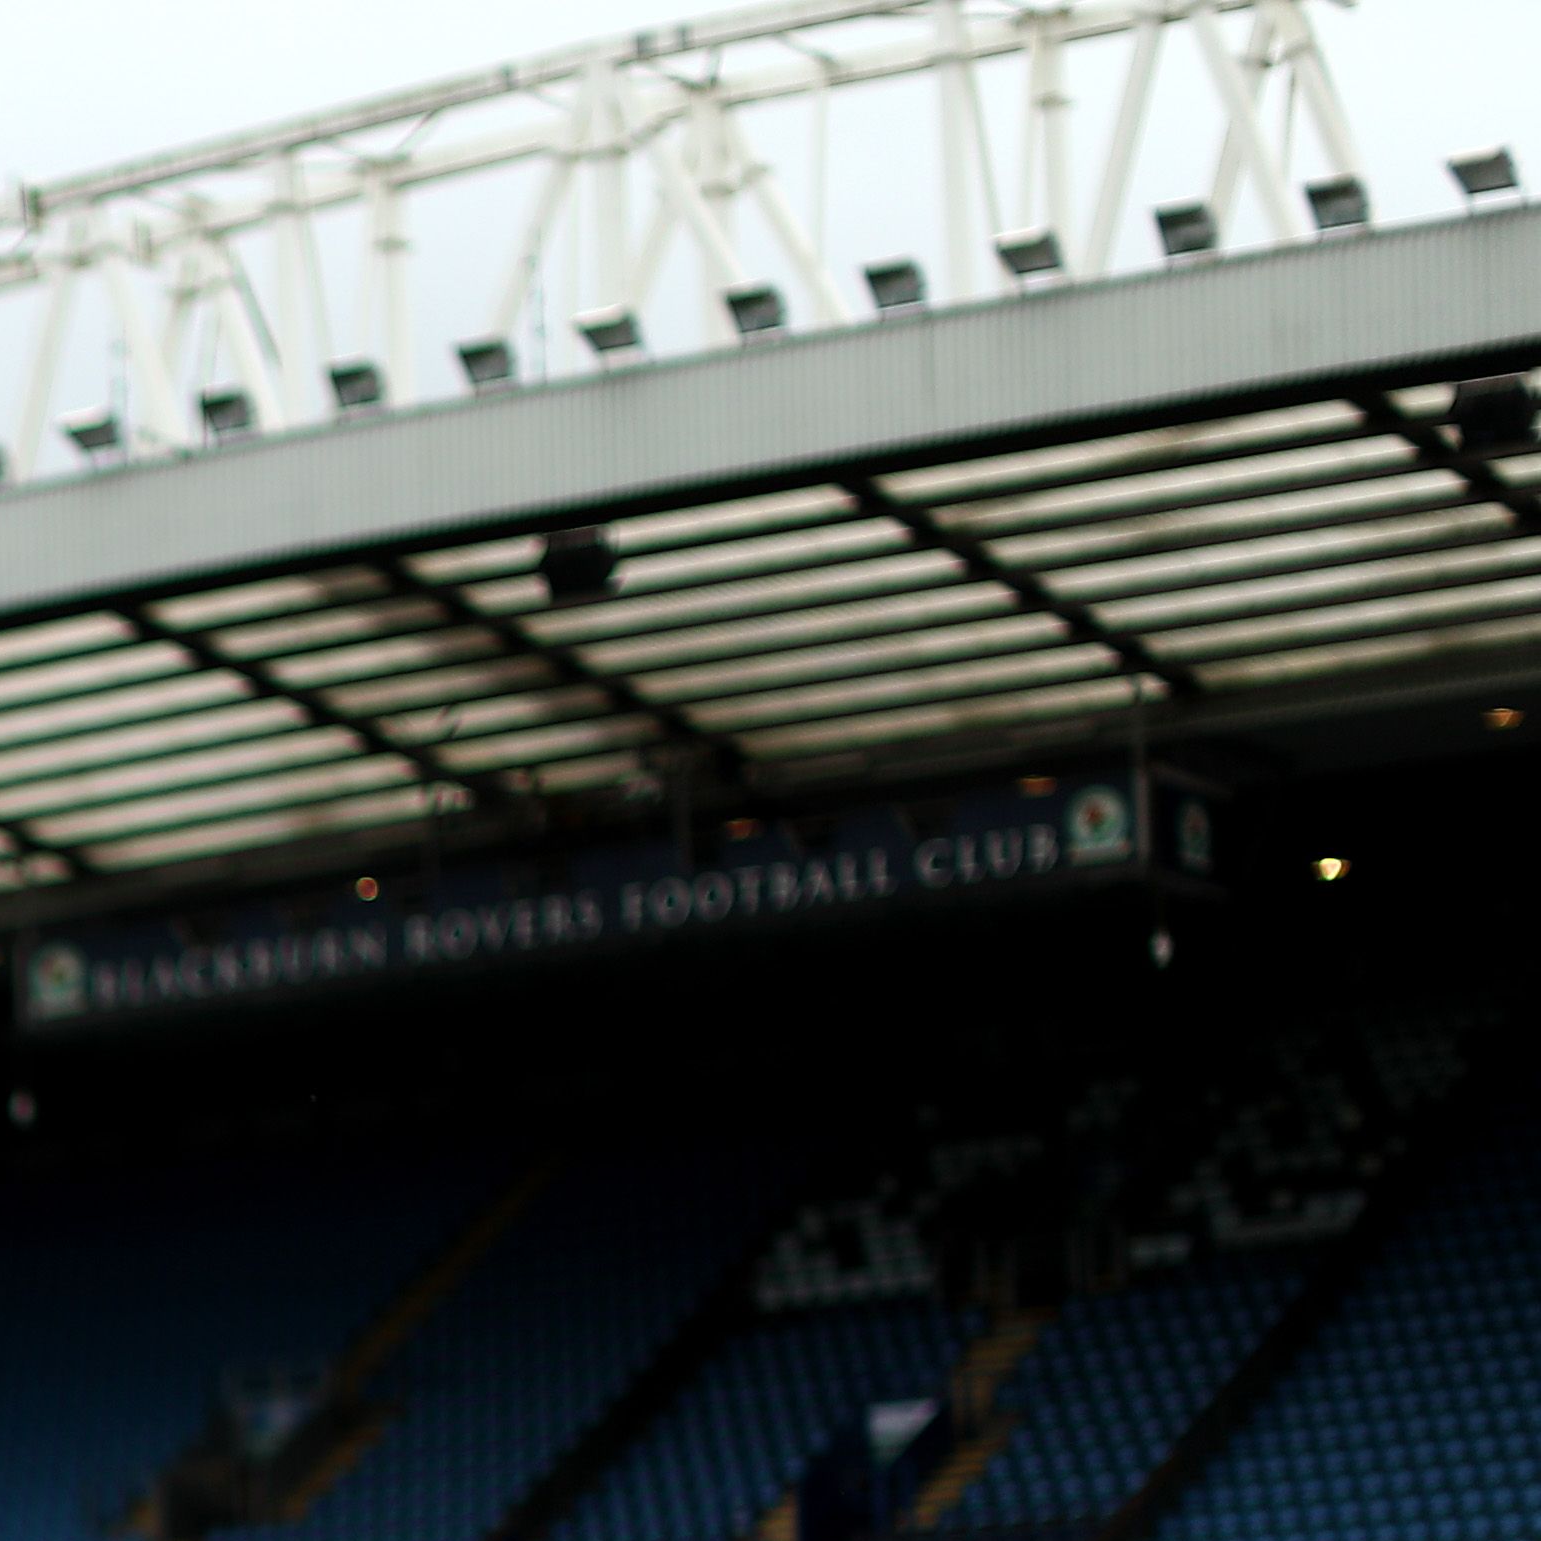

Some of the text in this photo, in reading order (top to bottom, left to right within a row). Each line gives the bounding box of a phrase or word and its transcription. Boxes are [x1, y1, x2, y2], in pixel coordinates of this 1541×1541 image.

[406, 892, 604, 962] ROVERS
[621, 852, 892, 933] FOOTBALL
[918, 823, 1059, 886] CLUB
